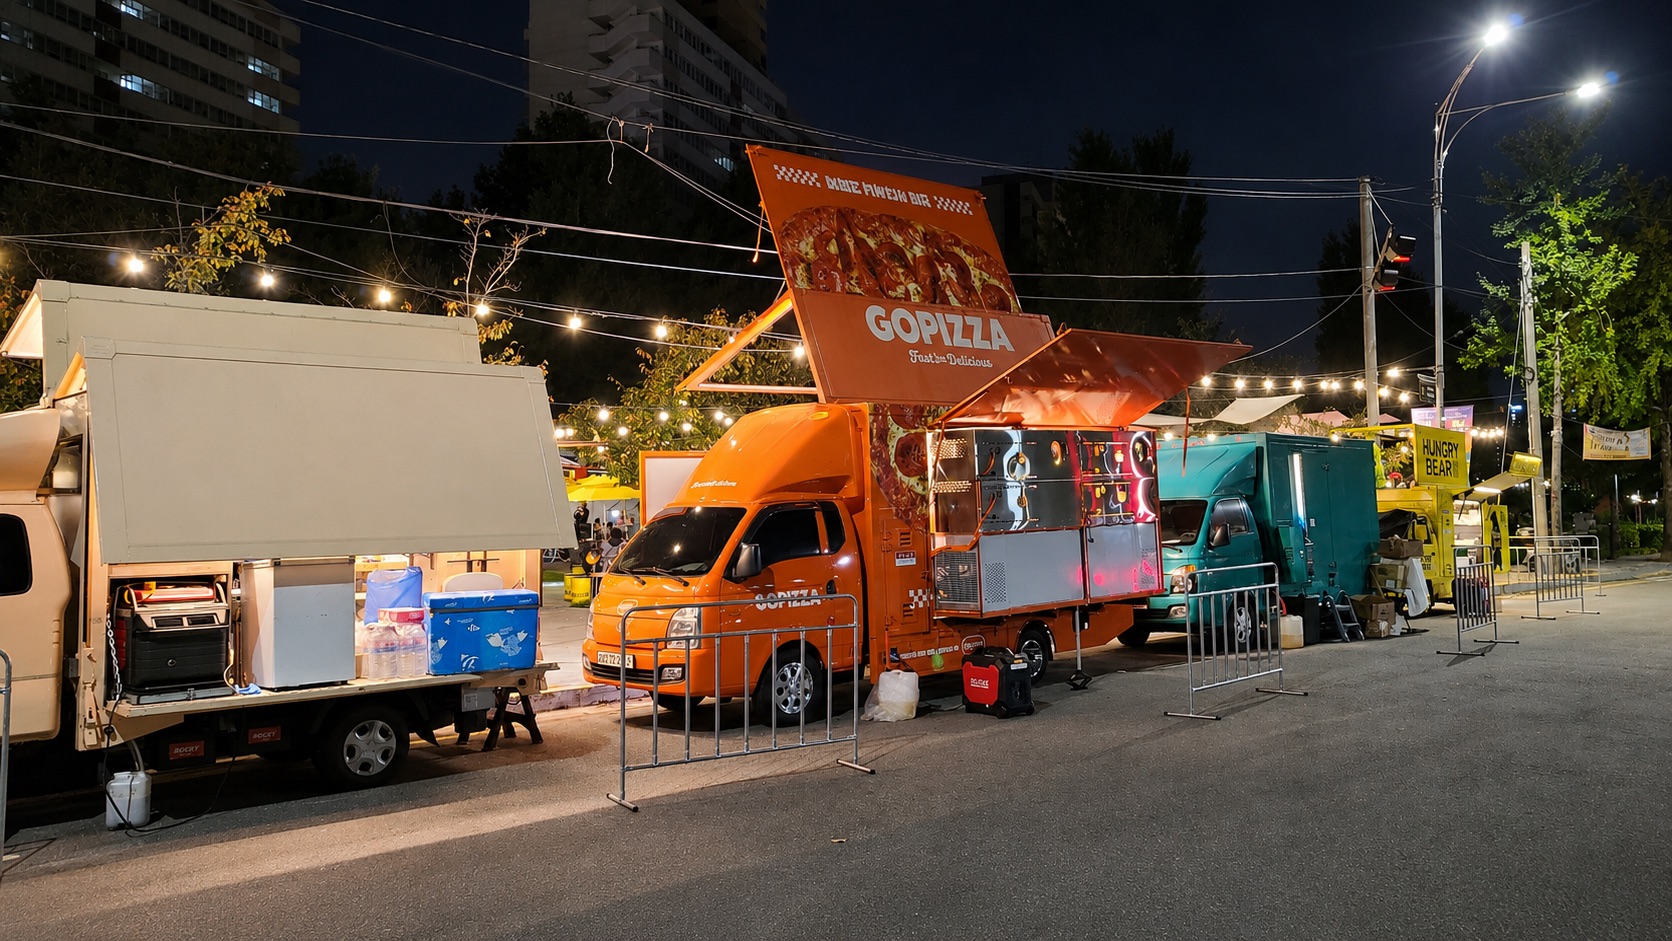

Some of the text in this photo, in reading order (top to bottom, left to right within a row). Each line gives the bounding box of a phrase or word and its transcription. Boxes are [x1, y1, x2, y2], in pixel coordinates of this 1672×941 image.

[865, 304, 1016, 352] GOPIZZA
[946, 353, 993, 368] Delicious
[1422, 438, 1459, 459] HUNGRY
[1425, 457, 1453, 477] BEAR
[755, 588, 822, 611] GOPIZZA
